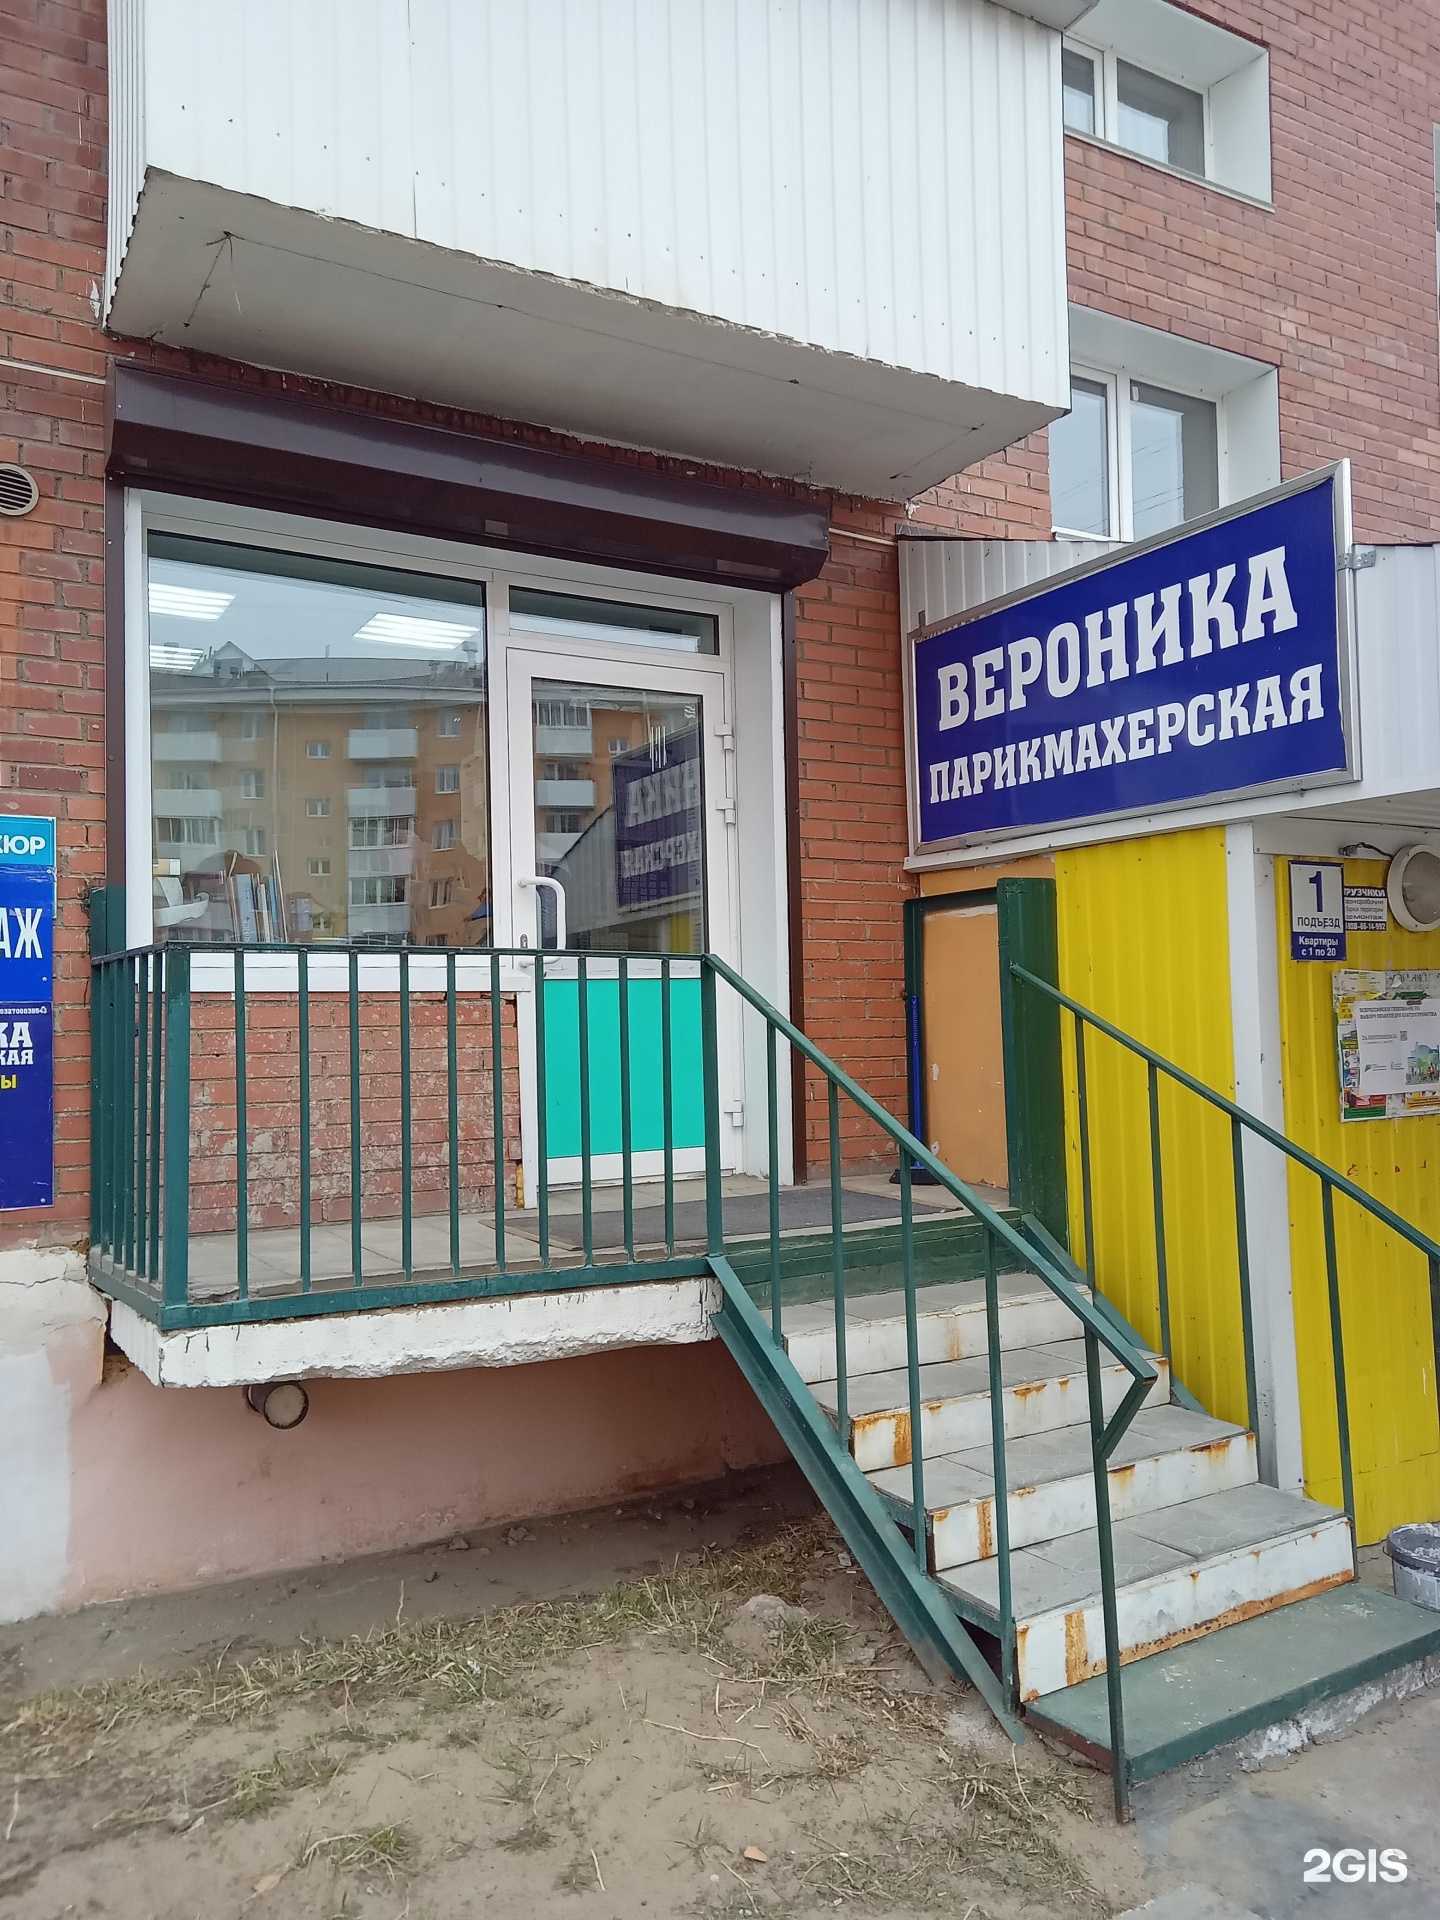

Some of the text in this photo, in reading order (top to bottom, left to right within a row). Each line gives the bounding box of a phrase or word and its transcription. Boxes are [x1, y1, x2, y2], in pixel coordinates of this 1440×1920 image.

[938, 545, 1298, 732] ВЕРОНИКА
[928, 663, 1325, 804] ПАРИКМАХЕРСКАЯ
[0, 834, 46, 855] ЮР
[1309, 870, 1323, 912] 1
[1297, 916, 1341, 929] ПОДЪЕЗД
[1298, 935, 1339, 947] Квартиры
[1308, 947, 1313, 956] 1
[1315, 949, 1326, 957] по
